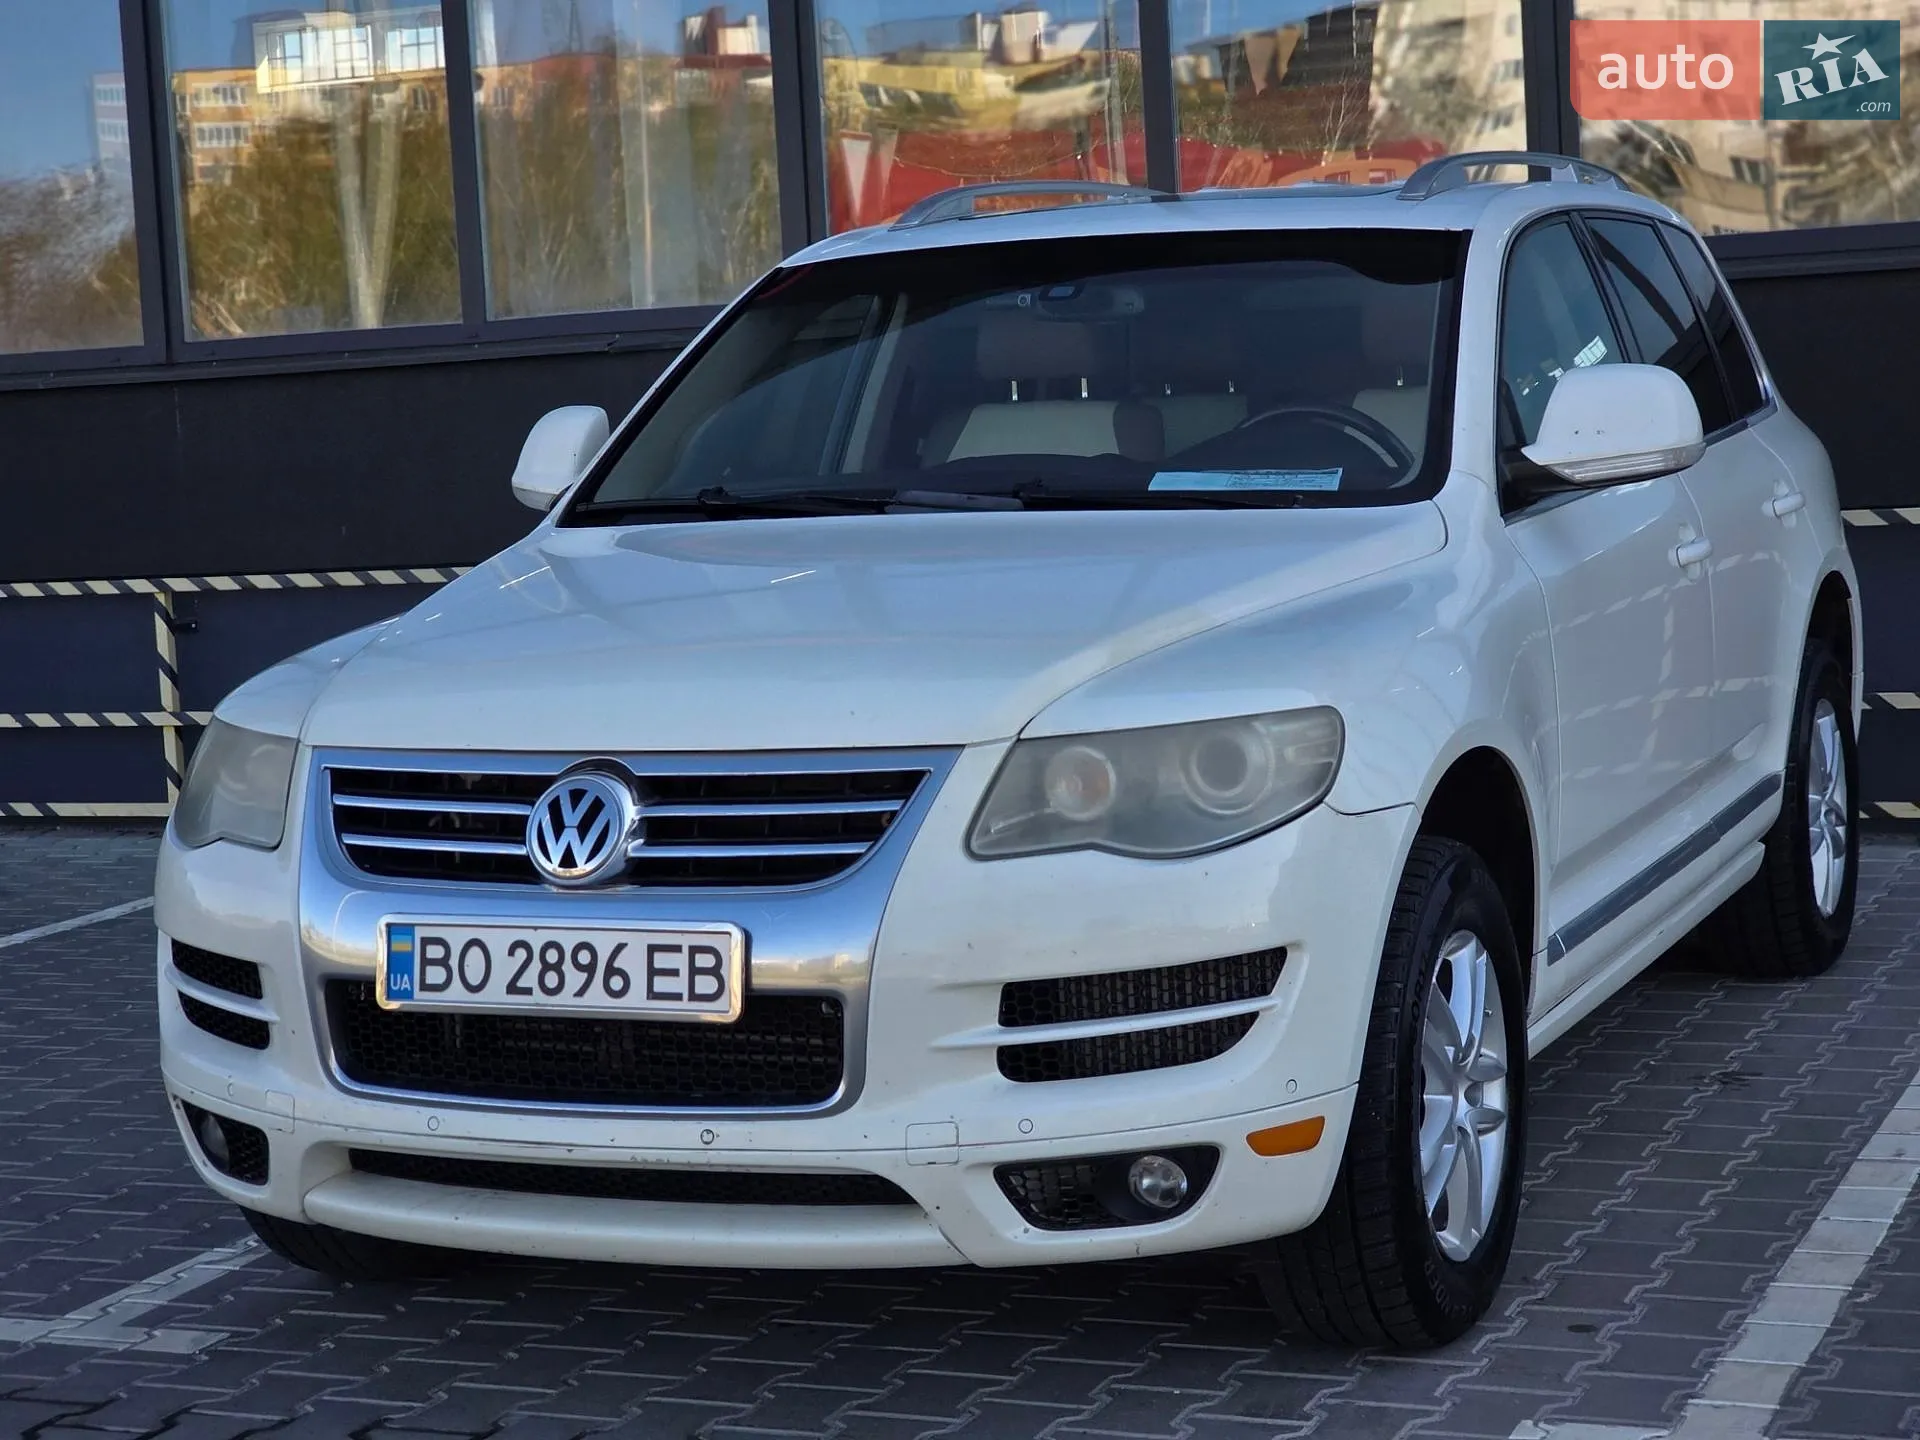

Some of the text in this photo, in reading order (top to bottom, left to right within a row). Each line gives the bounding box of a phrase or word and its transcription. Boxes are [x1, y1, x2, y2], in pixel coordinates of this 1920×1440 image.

[389, 972, 412, 992] UA
[418, 936, 727, 1003] BO 2896 EB
